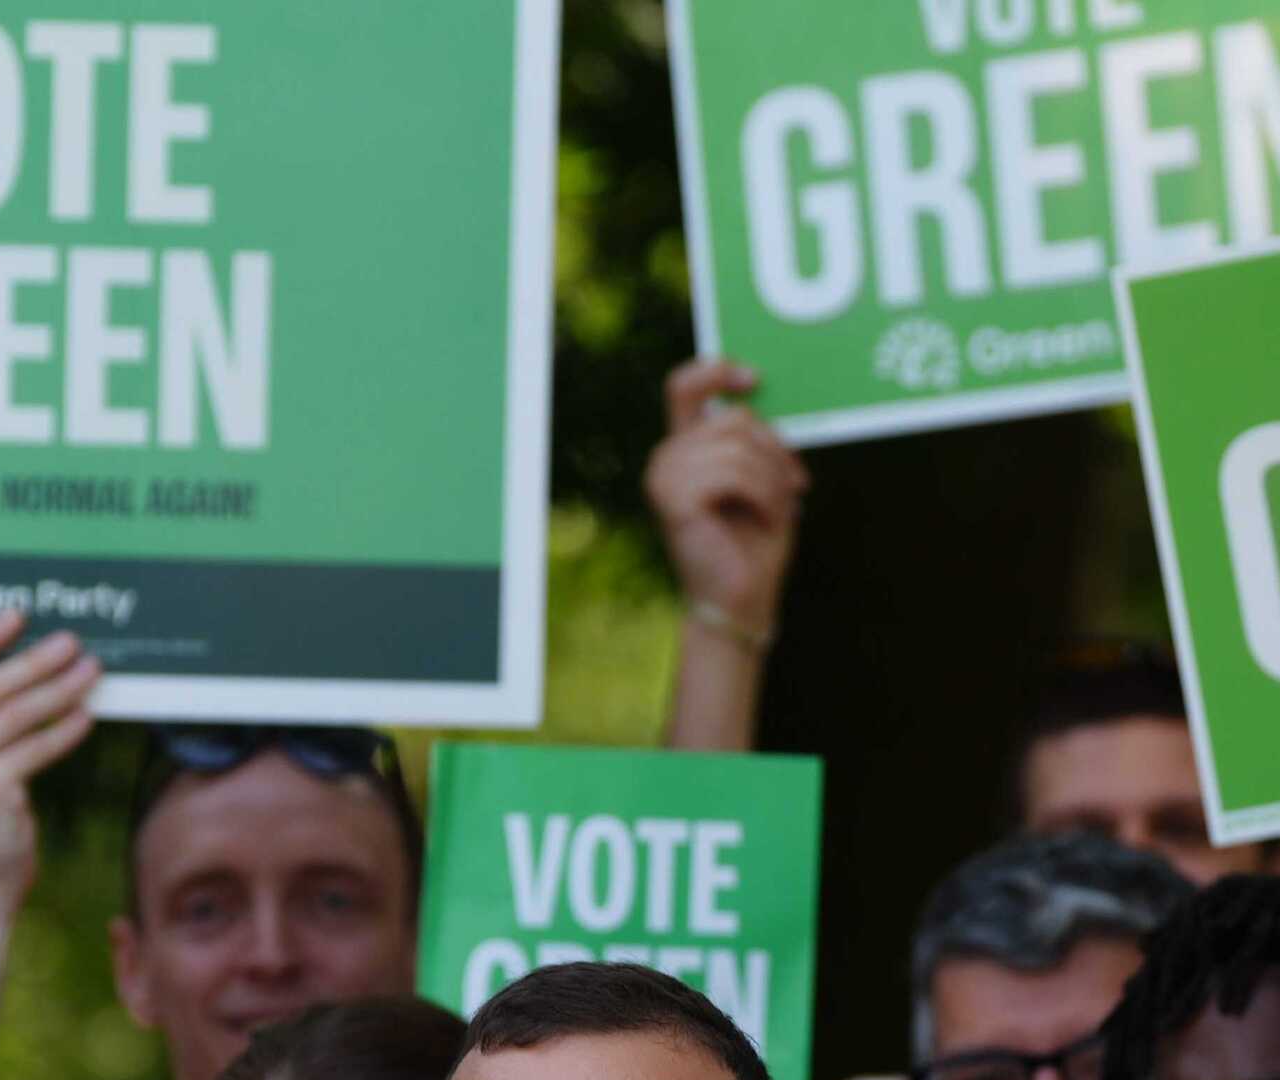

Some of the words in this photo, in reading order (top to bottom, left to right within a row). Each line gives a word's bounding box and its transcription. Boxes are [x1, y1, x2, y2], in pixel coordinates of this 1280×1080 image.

[967, 320, 1116, 377] Green
[0, 474, 135, 518] NORMAL
[36, 580, 137, 627] Party
[504, 813, 744, 936] VOTE
